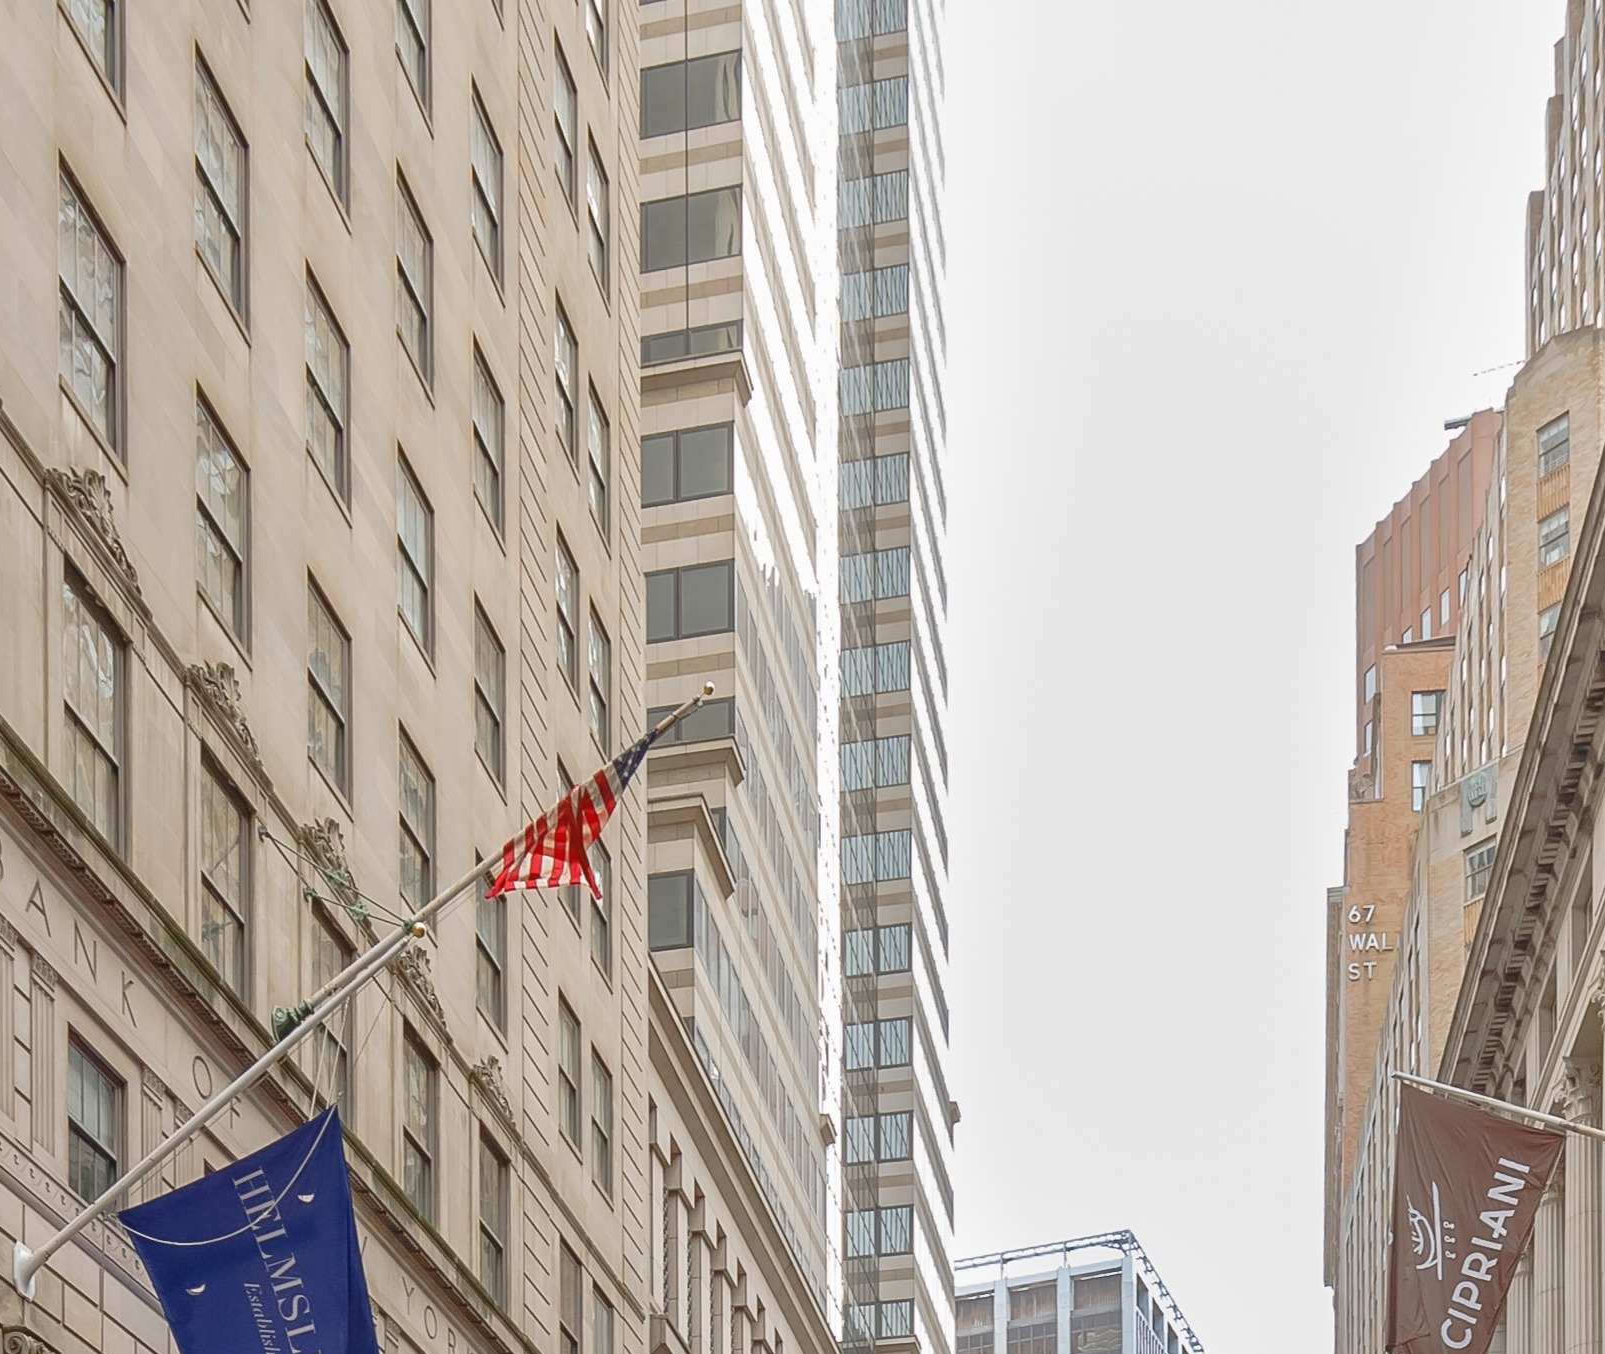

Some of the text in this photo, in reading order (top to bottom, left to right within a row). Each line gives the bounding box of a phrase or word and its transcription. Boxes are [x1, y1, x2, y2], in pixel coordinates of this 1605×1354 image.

[1348, 904, 1375, 923] 67
[1348, 961, 1377, 980] ST
[1440, 1157, 1531, 1350] CIPRIANI
